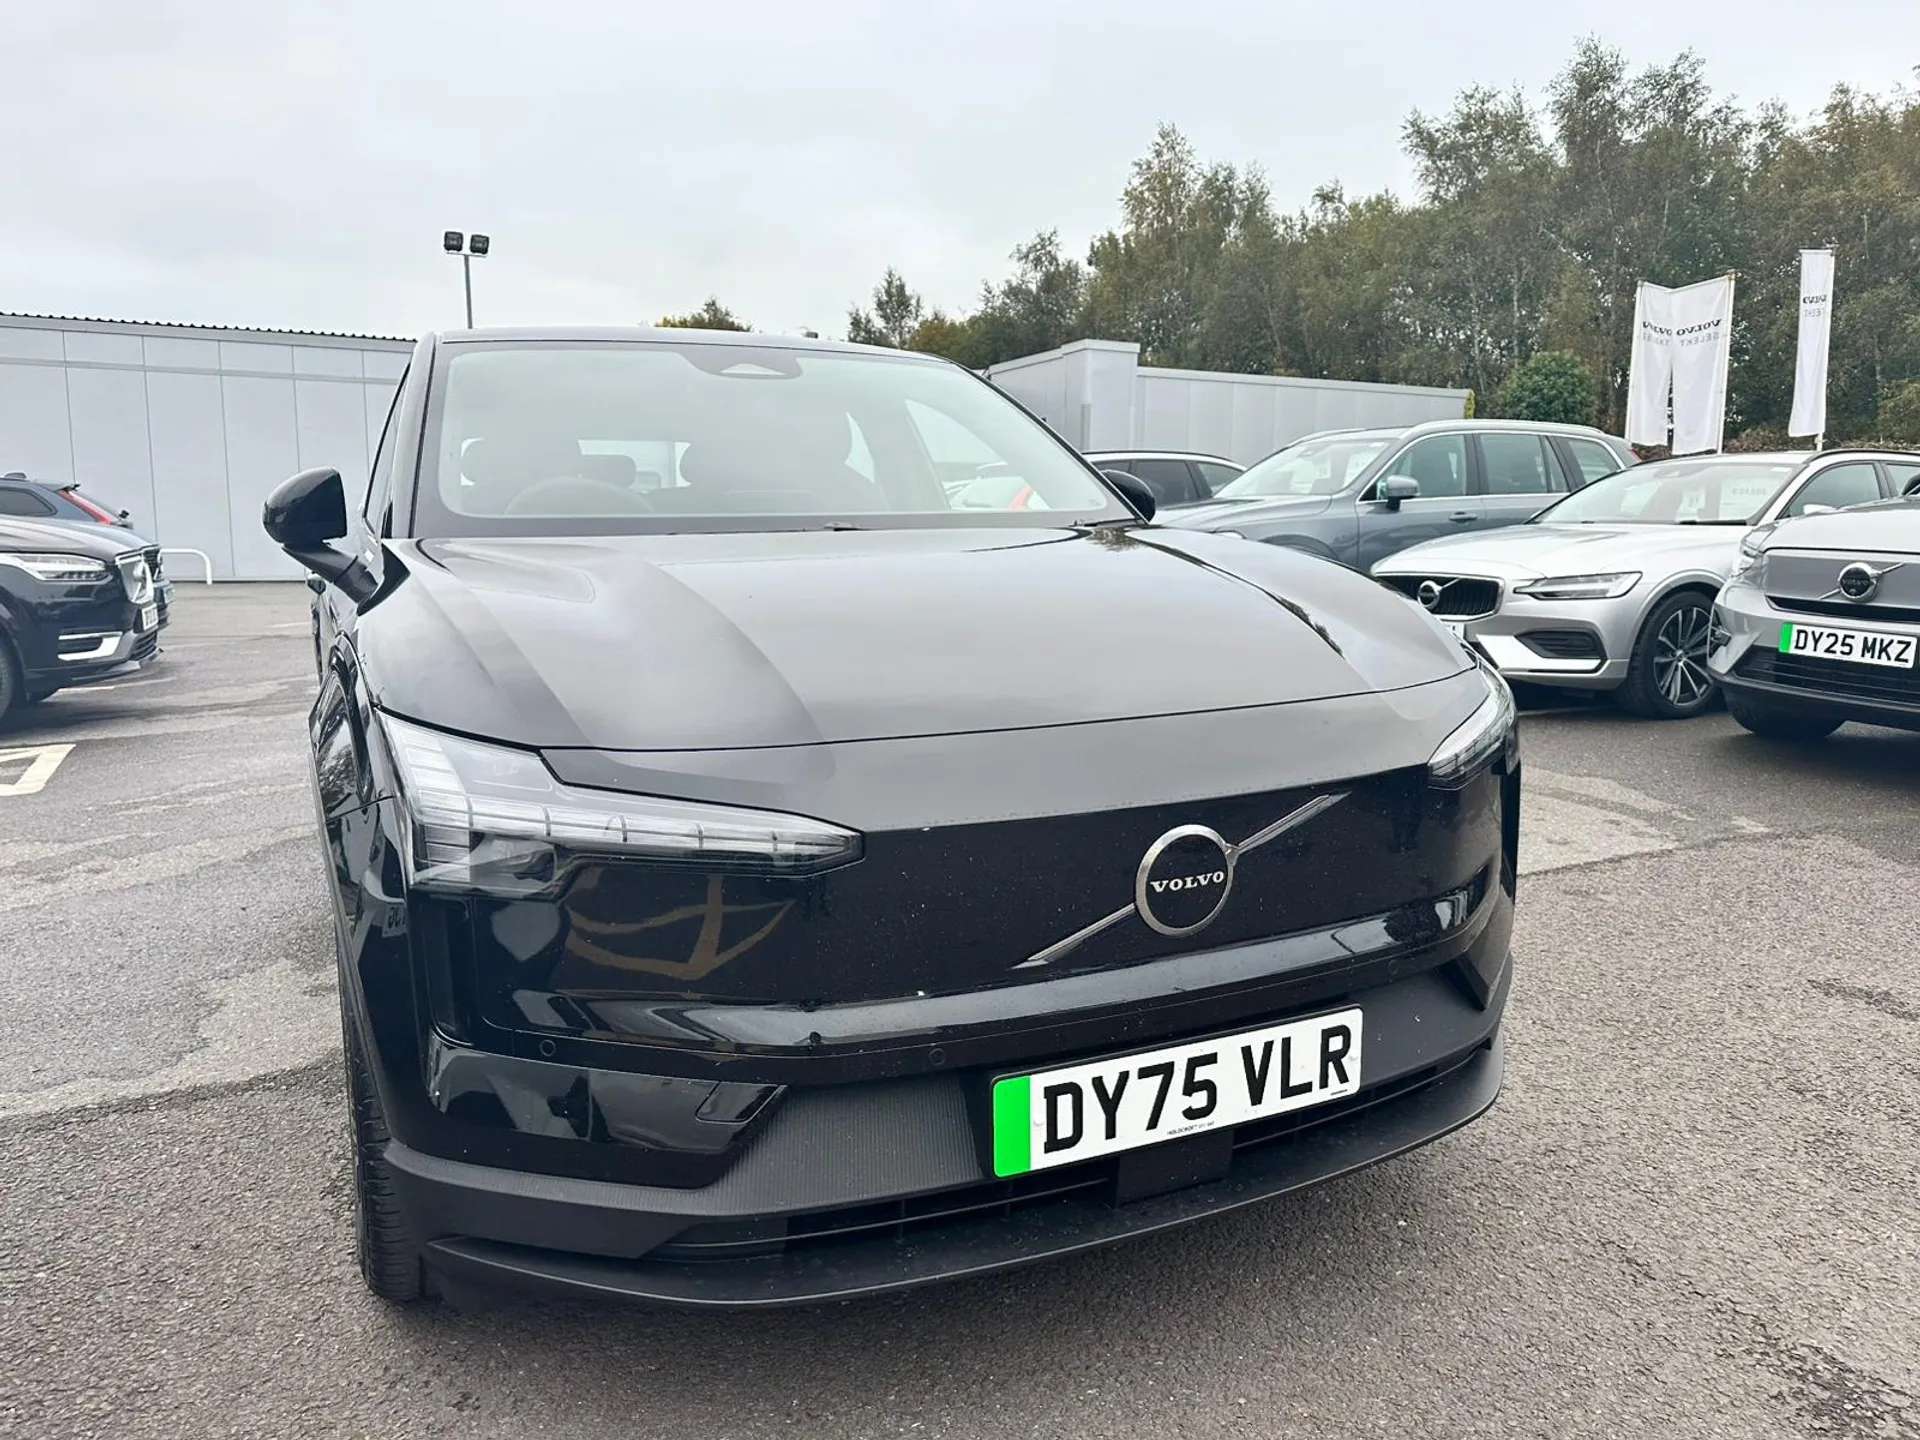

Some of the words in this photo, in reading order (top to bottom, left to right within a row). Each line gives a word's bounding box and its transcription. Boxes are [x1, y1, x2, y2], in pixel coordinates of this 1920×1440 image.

[1795, 629, 1855, 656] DY25
[1861, 636, 1912, 663] MKZ
[1150, 871, 1224, 893] VOLVO
[1043, 1052, 1218, 1154] DY75
[1241, 1024, 1351, 1106] VLR
